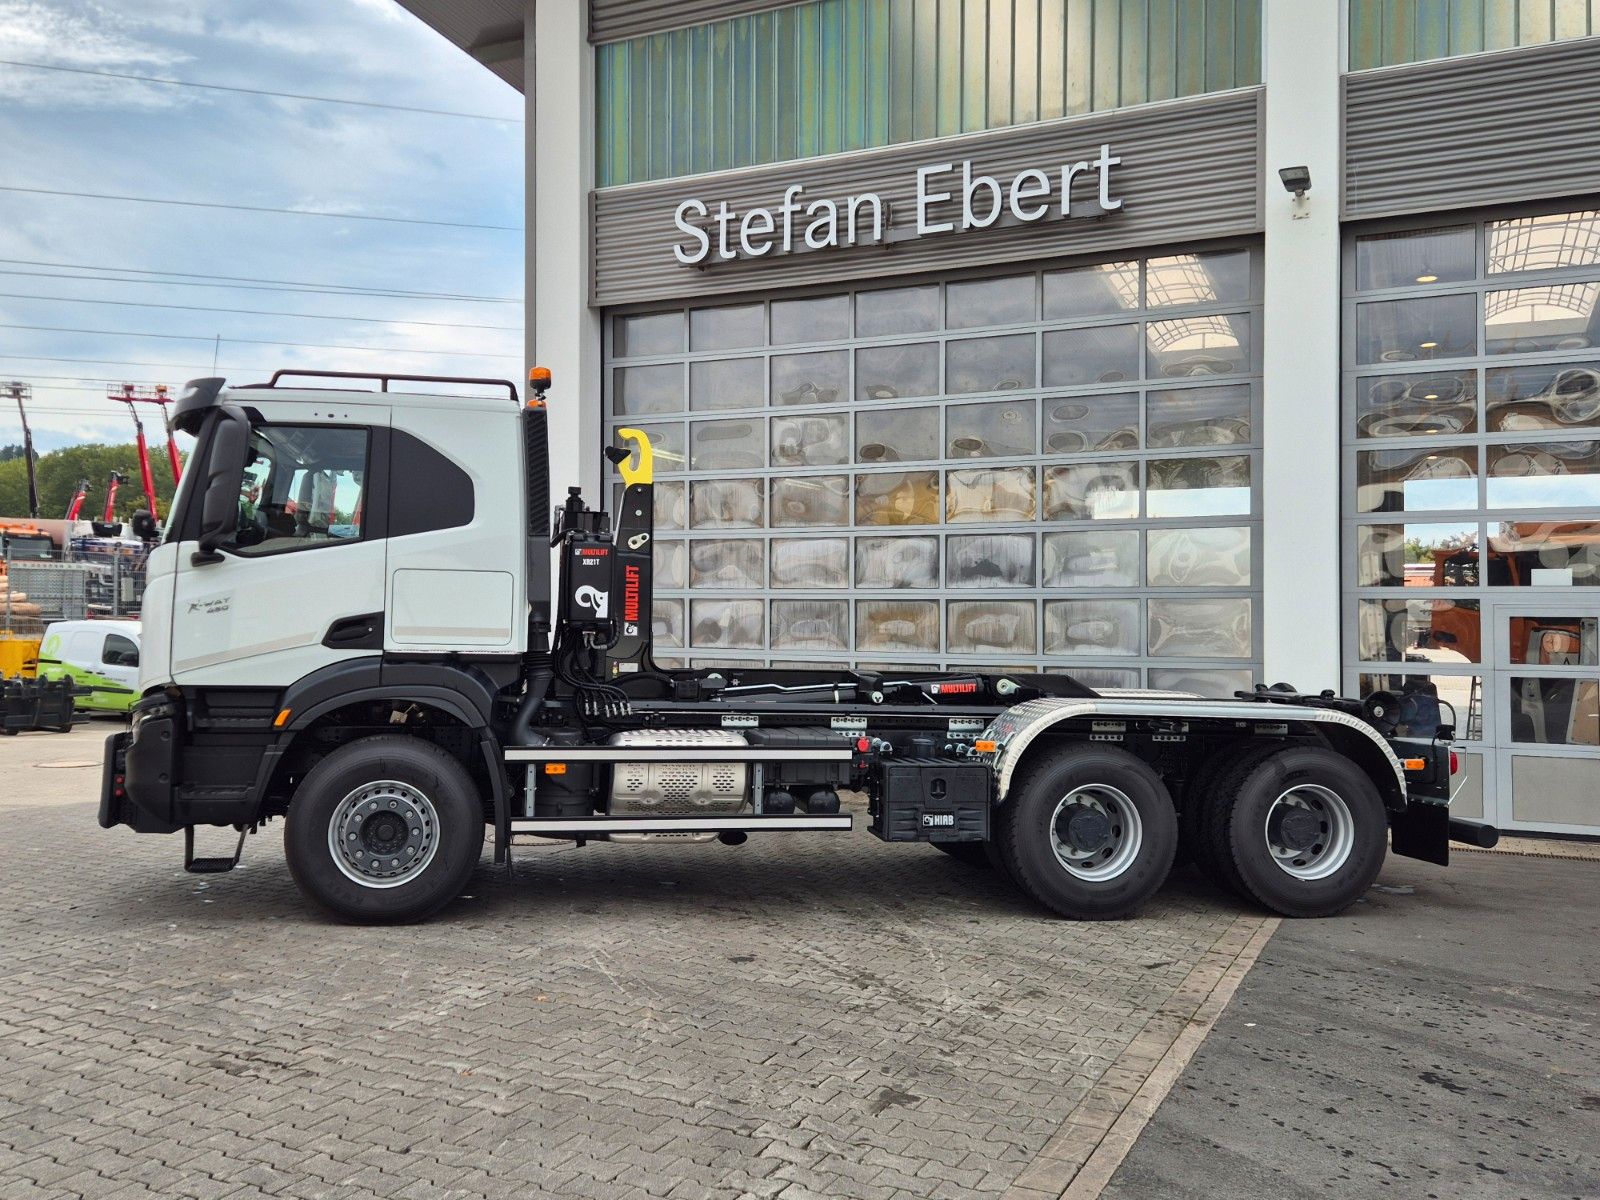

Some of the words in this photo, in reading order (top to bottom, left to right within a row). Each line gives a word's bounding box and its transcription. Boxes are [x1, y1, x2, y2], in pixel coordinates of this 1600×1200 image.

[673, 184, 882, 265] Stefan
[916, 144, 1122, 235] Ebert
[624, 565, 640, 621] MULTILIFT
[940, 683, 977, 694] MULTILIFT
[934, 814, 954, 826] HIAB
